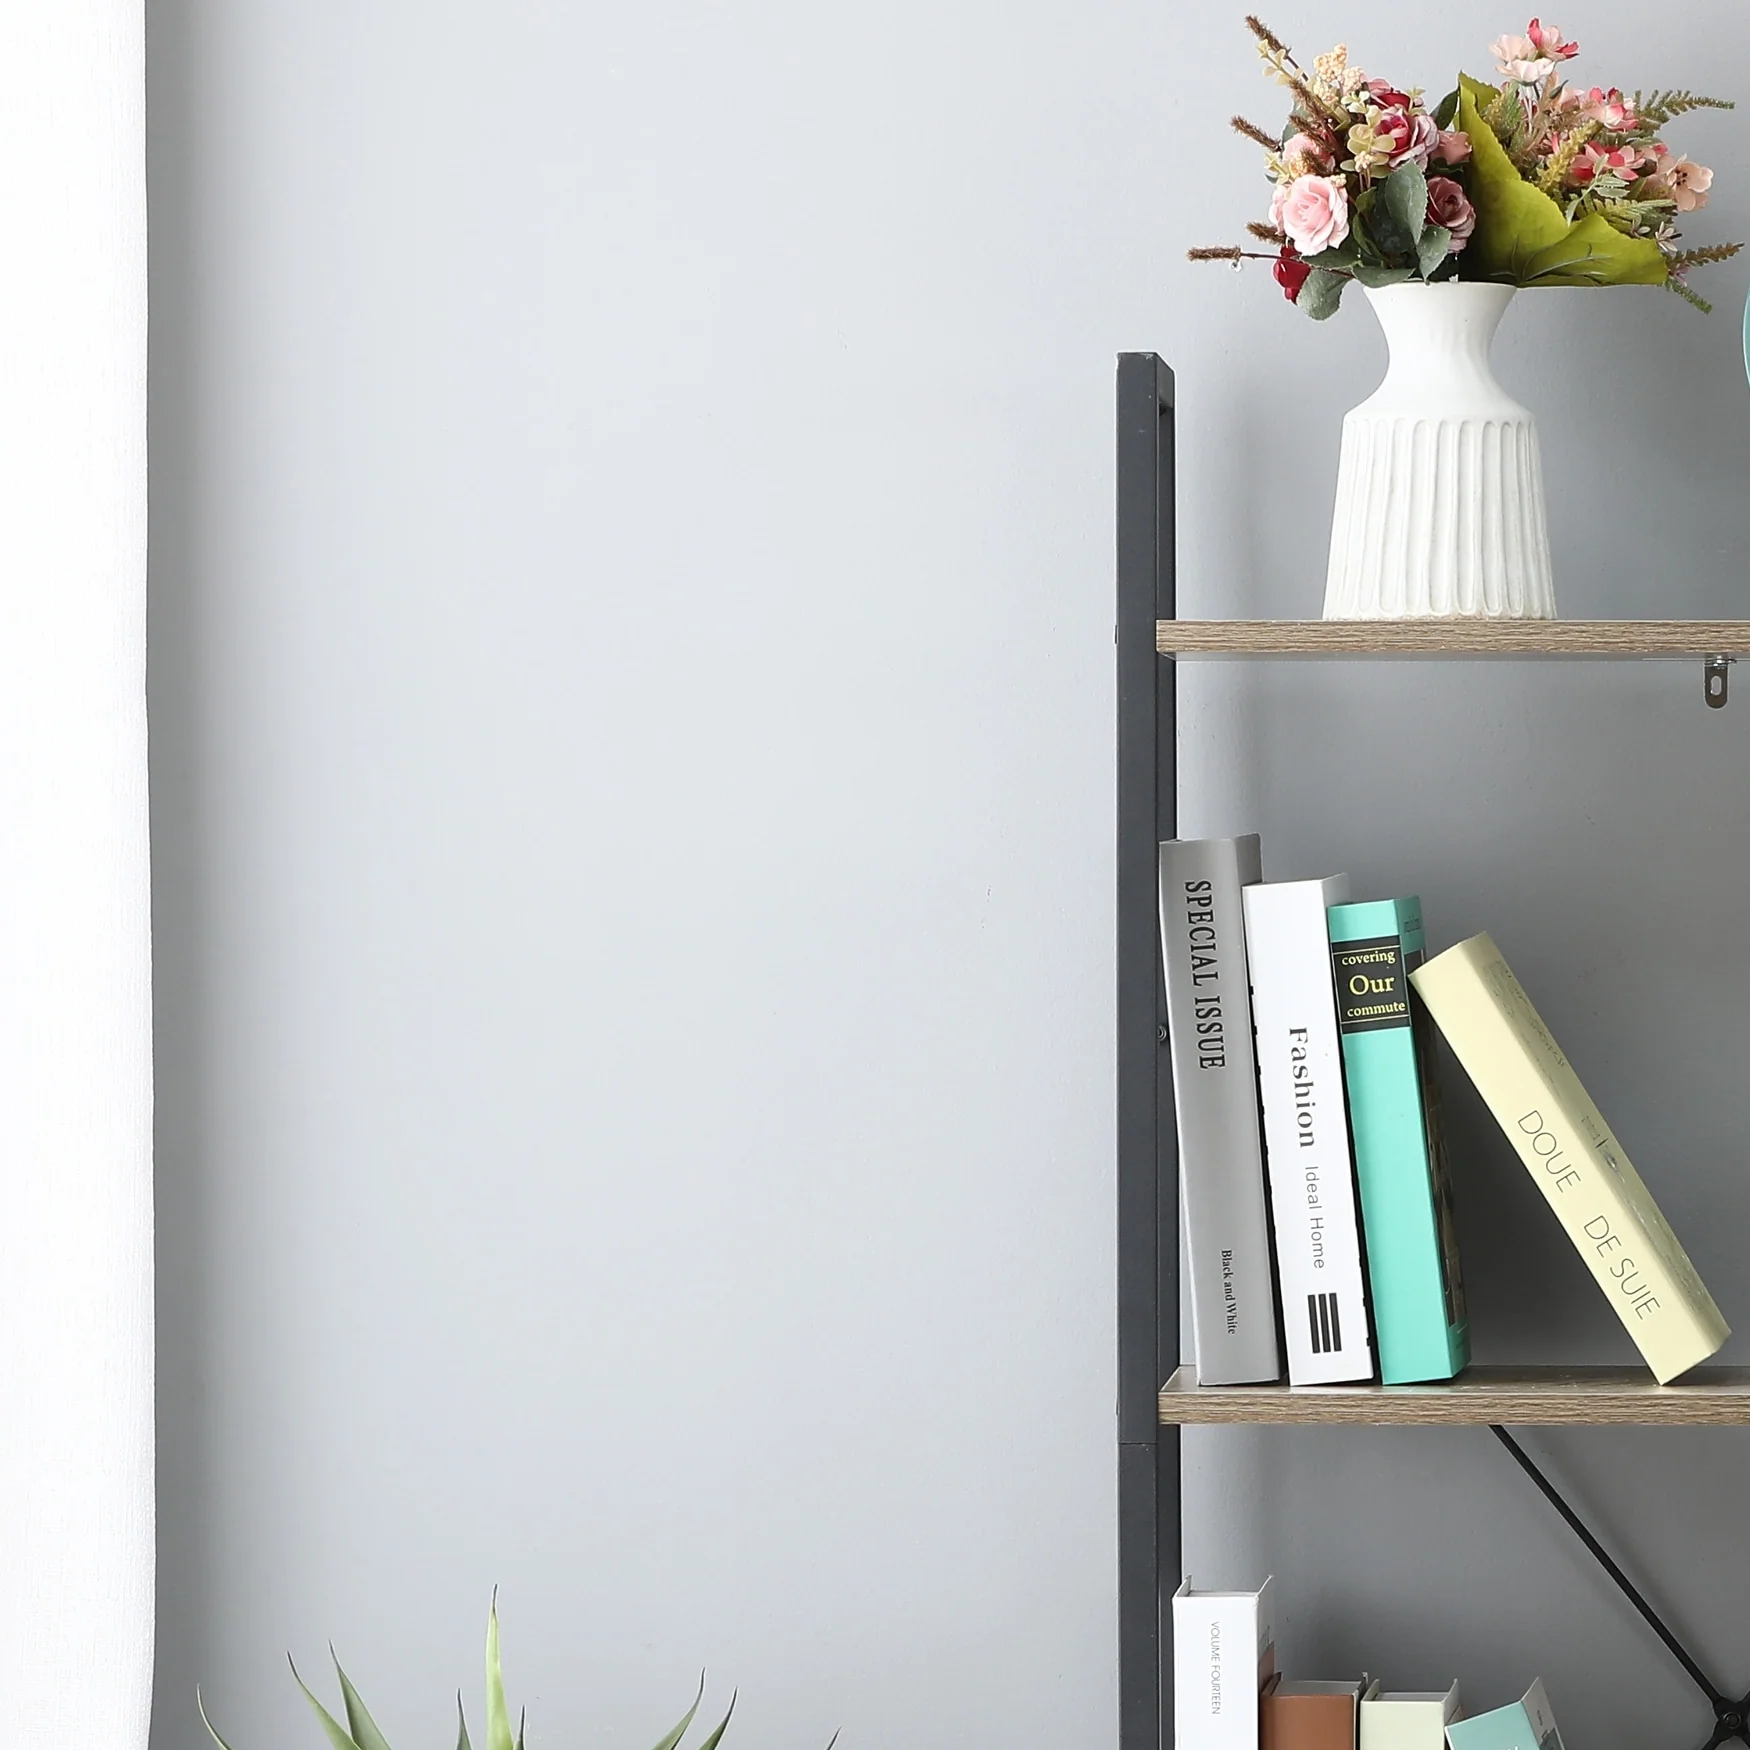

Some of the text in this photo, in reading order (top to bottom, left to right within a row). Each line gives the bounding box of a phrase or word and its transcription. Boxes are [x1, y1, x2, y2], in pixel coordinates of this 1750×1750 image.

[1184, 880, 1226, 1070] SPECIAL ISSUE
[1342, 950, 1396, 965] covering
[1349, 974, 1395, 995] Our
[1347, 1001, 1406, 1017] commute
[1289, 1027, 1315, 1148] Fashion
[1305, 1166, 1325, 1270] Ideal Home
[1518, 1110, 1581, 1194] DOUE
[1583, 1215, 1622, 1258] DE
[1609, 1258, 1661, 1321] SUIE
[1221, 1249, 1238, 1335] Black and White
[1211, 1621, 1221, 1715] VOLUME FOURTEEN
